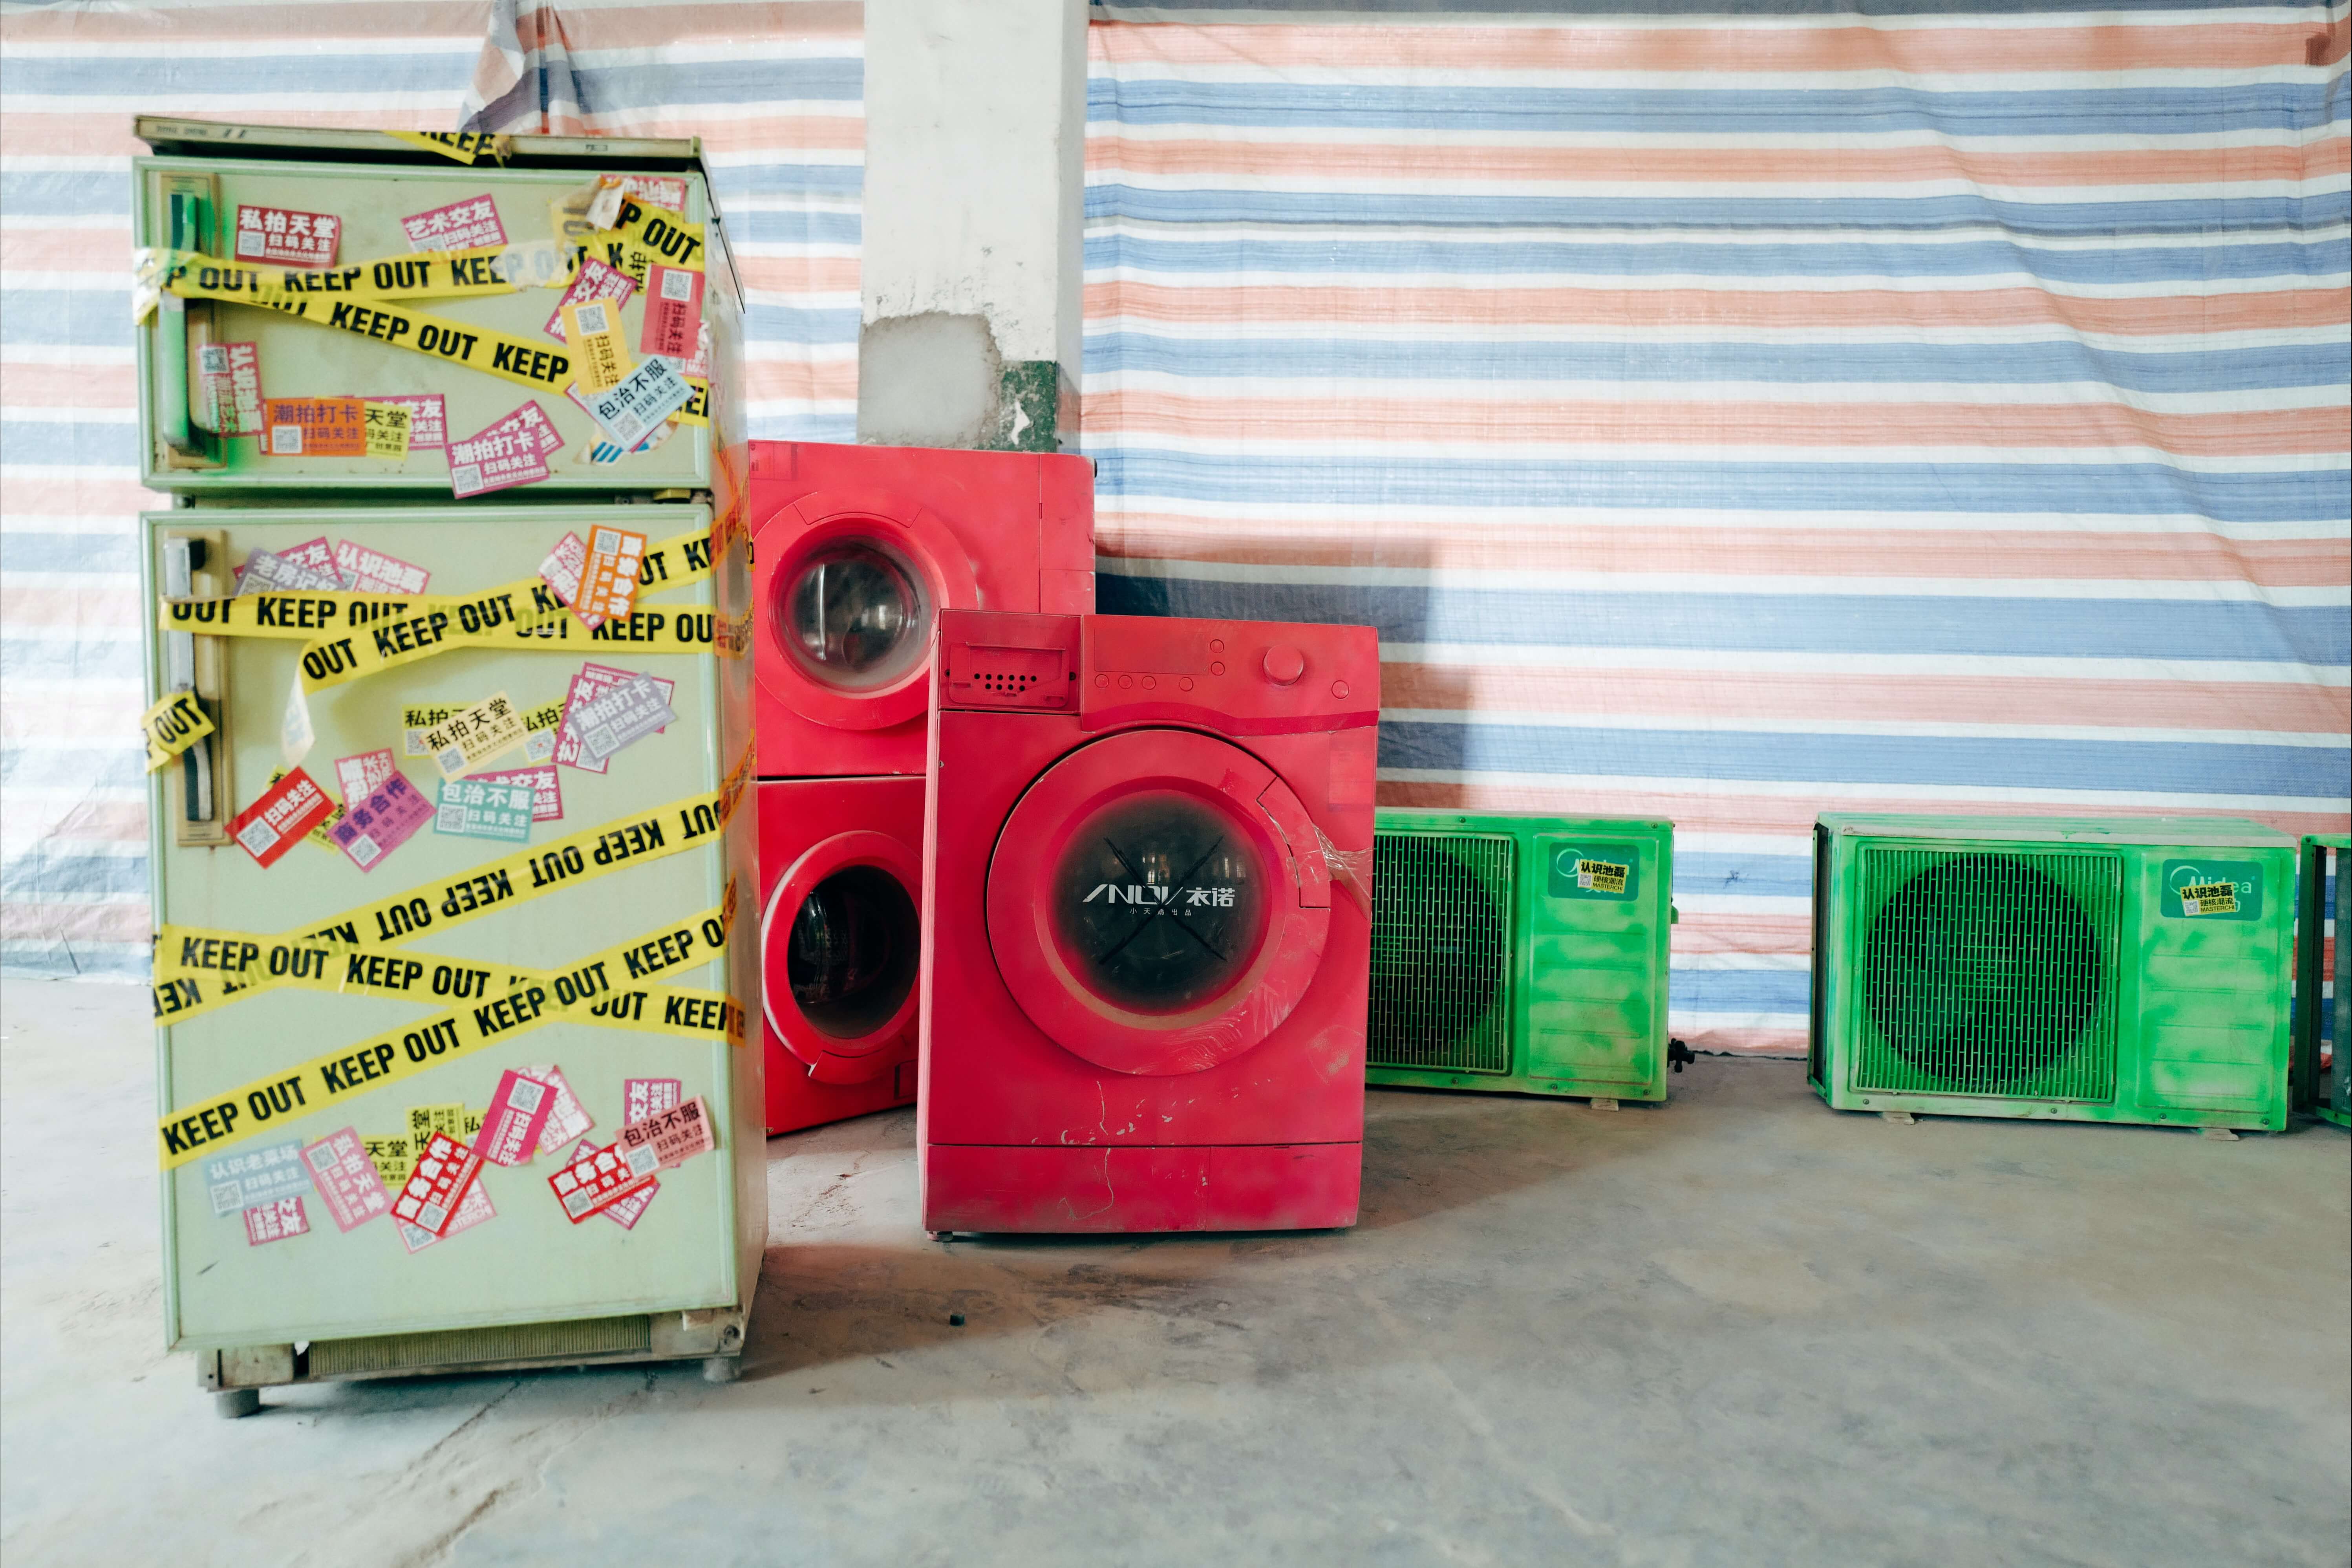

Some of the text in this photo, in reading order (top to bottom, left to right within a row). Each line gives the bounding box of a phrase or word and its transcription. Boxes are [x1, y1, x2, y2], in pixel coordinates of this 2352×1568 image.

[240, 208, 336, 238] 私拍天堂
[406, 200, 495, 239] 艺术交友
[444, 219, 499, 245] 扫码关注
[269, 233, 331, 252] 扫码关注
[642, 218, 701, 265] OUT
[199, 267, 263, 293] OUT
[284, 266, 362, 293] KEEP
[373, 261, 431, 289] OUT
[328, 302, 410, 342] KEEP
[417, 325, 478, 361] OUT
[492, 342, 569, 383] KEEP
[669, 302, 688, 354] 扫码关注
[594, 335, 620, 386] 扫码关注
[599, 359, 668, 420] 包治不服
[633, 376, 677, 416] 扫码关注
[274, 404, 358, 423] 潮拍打卡
[304, 427, 359, 439] 扫码关注
[365, 408, 407, 428] 天堂
[452, 430, 534, 465] 潮拍打卡
[484, 452, 538, 475] 扫码关注
[337, 545, 427, 592] 认识池磊
[591, 555, 616, 613] 扫码关注
[608, 535, 643, 617] 商务合作
[172, 597, 236, 624] OUT
[257, 596, 337, 628] KEEP
[349, 601, 408, 629] OUT
[592, 613, 664, 641] KEEP
[676, 613, 715, 643] OU
[303, 638, 358, 680] OUT
[372, 611, 448, 659] KEEP
[459, 593, 515, 633] OUT
[155, 698, 202, 743] OUT
[426, 698, 511, 751] 私拍天堂
[575, 678, 651, 731] 潮拍打卡
[611, 697, 662, 733] 扫码关注
[462, 717, 518, 751] 扫码关注
[263, 779, 316, 827] 扫码关注
[334, 778, 407, 844] 商务合作
[441, 783, 530, 811] 包治不服
[468, 809, 528, 828] 扫码关注
[594, 819, 665, 865] KEEP
[529, 845, 584, 887] OUT
[1581, 861, 1625, 878] 认识池磊
[1592, 882, 1623, 891] MASTERCHI
[1593, 875, 1623, 886] 硬核潮流
[441, 869, 514, 917] KEEP
[1186, 887, 1235, 908] 衣诺
[2182, 884, 2233, 900] 认识池磊
[2200, 897, 2234, 907] 硬核潮流
[375, 897, 432, 941] OUT
[181, 937, 259, 972] KEEP
[270, 946, 329, 979] OUT
[347, 953, 423, 990] KEEP
[432, 965, 490, 999] OUT
[161, 1102, 240, 1156] KEEP
[248, 1076, 306, 1122] OUT
[320, 1043, 394, 1094] KEEP
[403, 1018, 461, 1063] OUT
[474, 987, 546, 1037] KEEP
[553, 962, 609, 1006] OUT
[623, 929, 693, 979] KEEP
[498, 1111, 532, 1166] 扫码关注
[624, 1101, 700, 1147] 包治不服
[657, 1124, 704, 1151] 扫码关注
[210, 1145, 299, 1180] 认识老菜场
[365, 1141, 408, 1158] 天堂
[245, 1166, 300, 1190] 扫码关注
[329, 1166, 366, 1219] 扫码关注
[333, 1133, 385, 1213] 私拍天堂
[395, 1137, 452, 1220] 商务合作
[428, 1146, 469, 1206] 扫码关注
